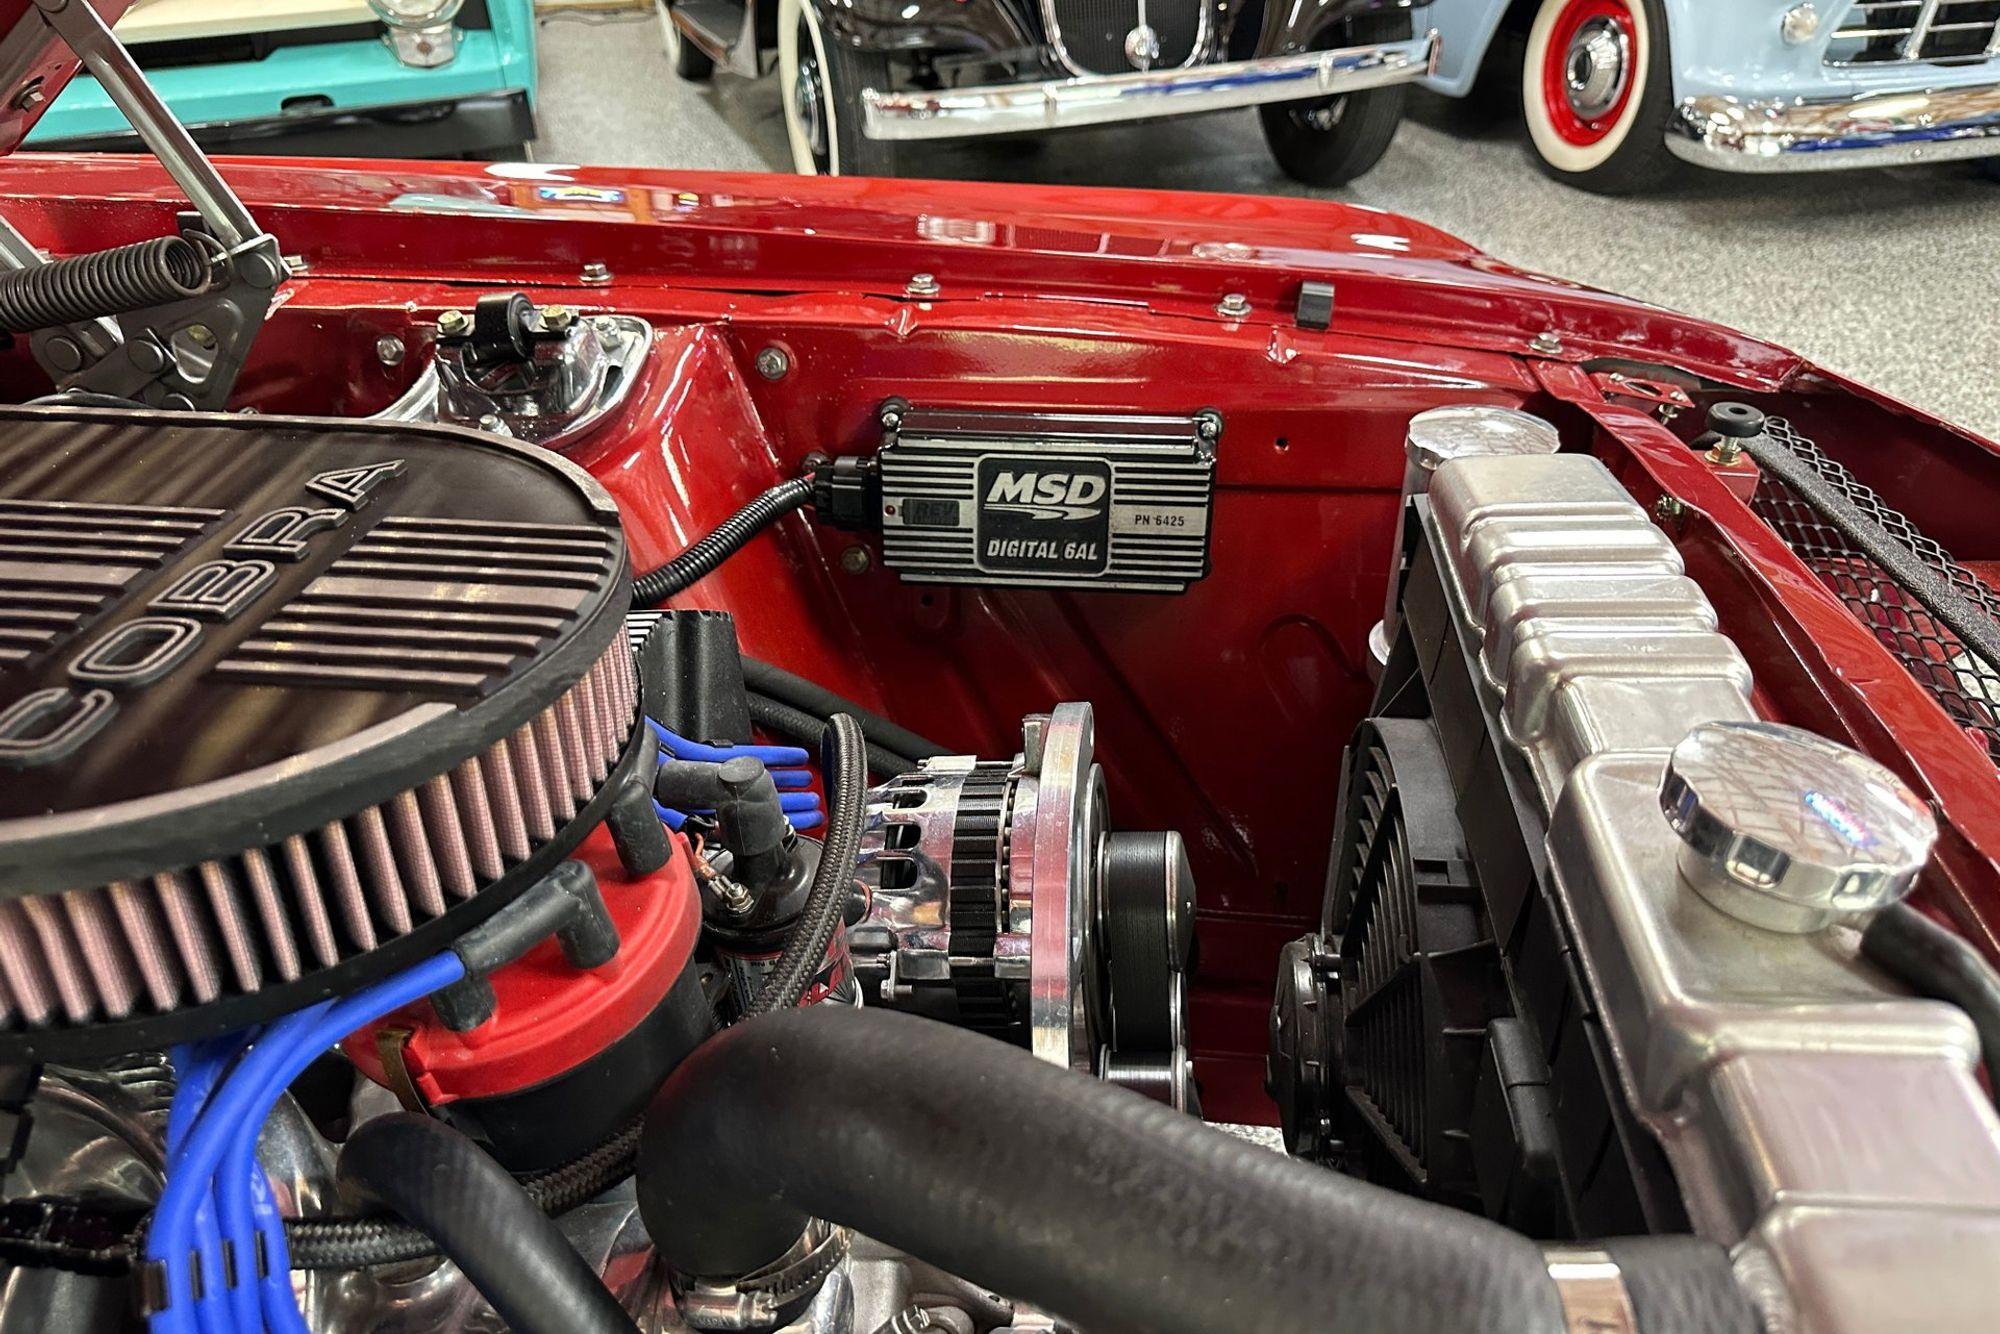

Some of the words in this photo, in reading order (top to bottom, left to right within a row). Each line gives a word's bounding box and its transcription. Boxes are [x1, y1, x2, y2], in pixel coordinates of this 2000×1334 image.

[986, 472, 1107, 506] MSD
[1134, 514, 1151, 526] PN
[1155, 514, 1185, 527] 6425
[987, 539, 1059, 559] DIGITAL
[1064, 541, 1098, 560] 6AL
[0, 459, 405, 764] COBRA
